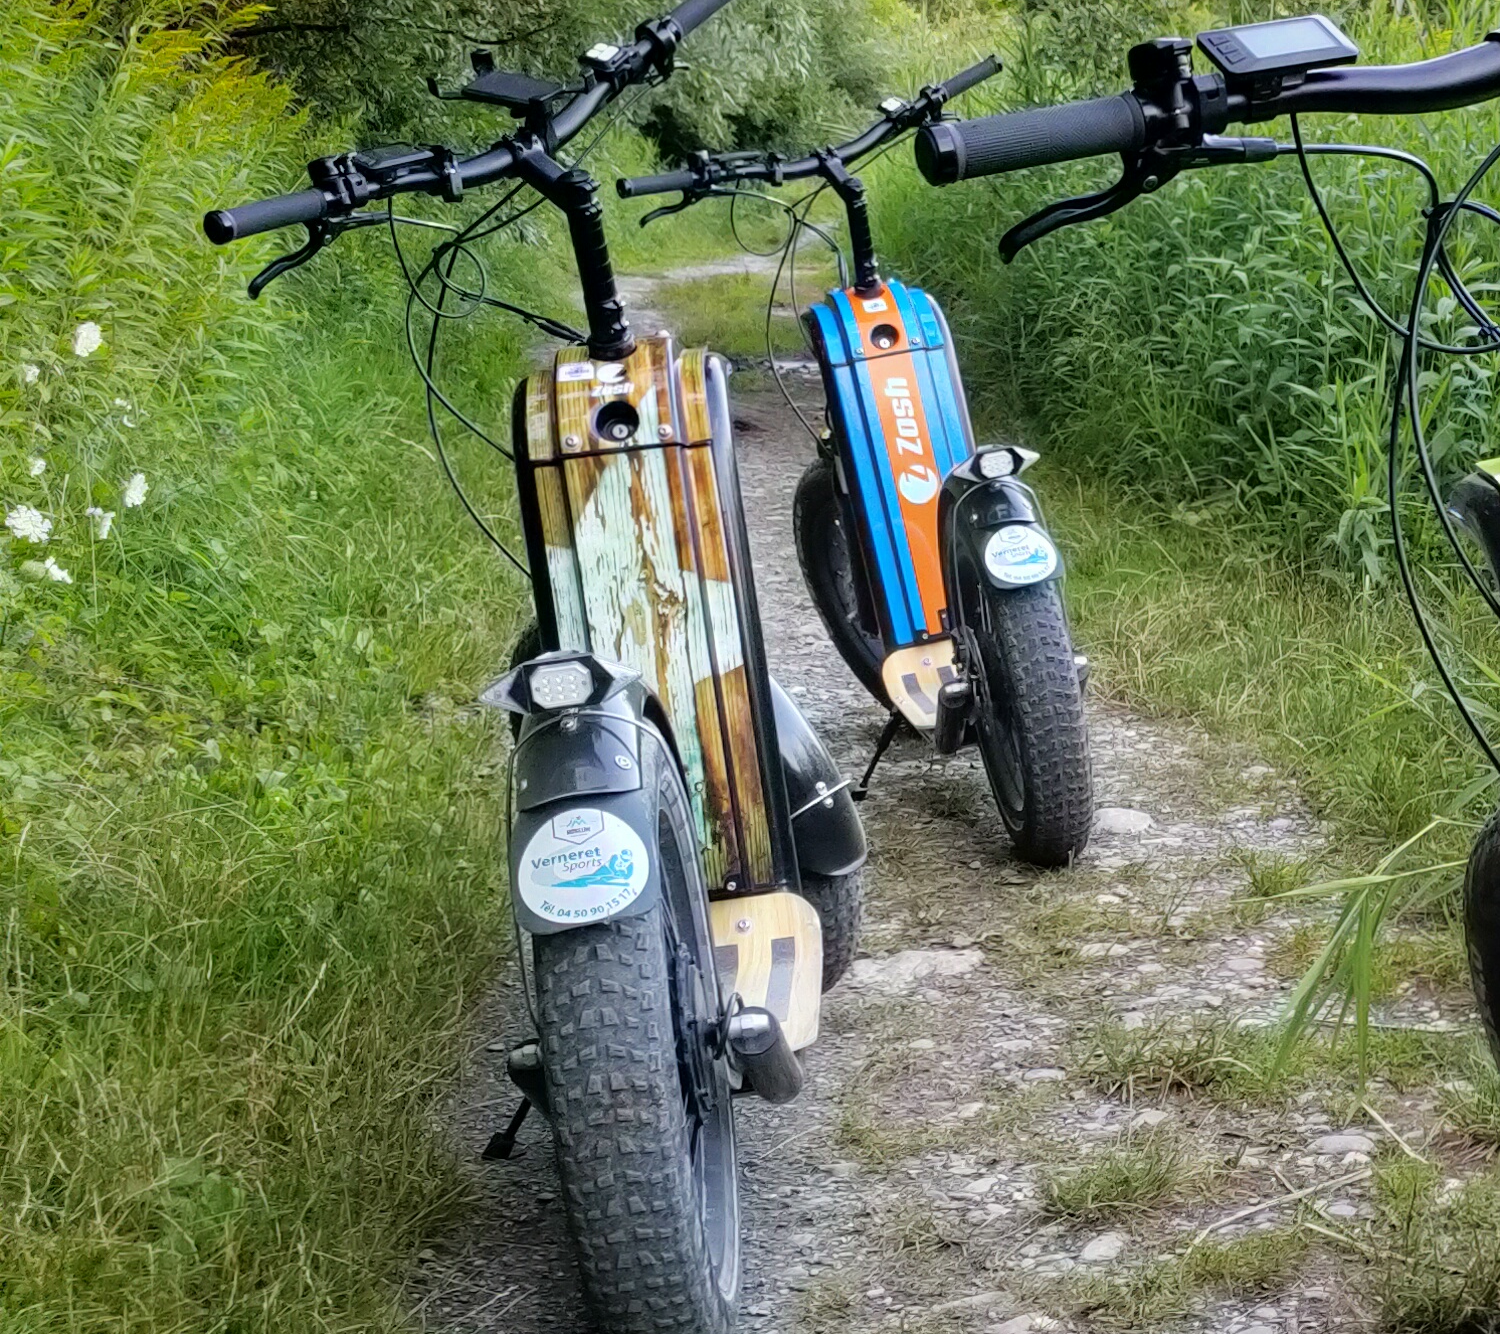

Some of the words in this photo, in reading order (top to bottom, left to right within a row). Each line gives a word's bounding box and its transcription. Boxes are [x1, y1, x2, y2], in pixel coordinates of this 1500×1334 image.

[531, 846, 602, 869] Verneret
[562, 857, 603, 873] Sports
[540, 900, 555, 915] Tél.
[557, 908, 571, 918] 04
[573, 908, 588, 919] 50
[590, 905, 605, 916] 90
[606, 897, 620, 910] 15
[619, 888, 631, 900] 17
